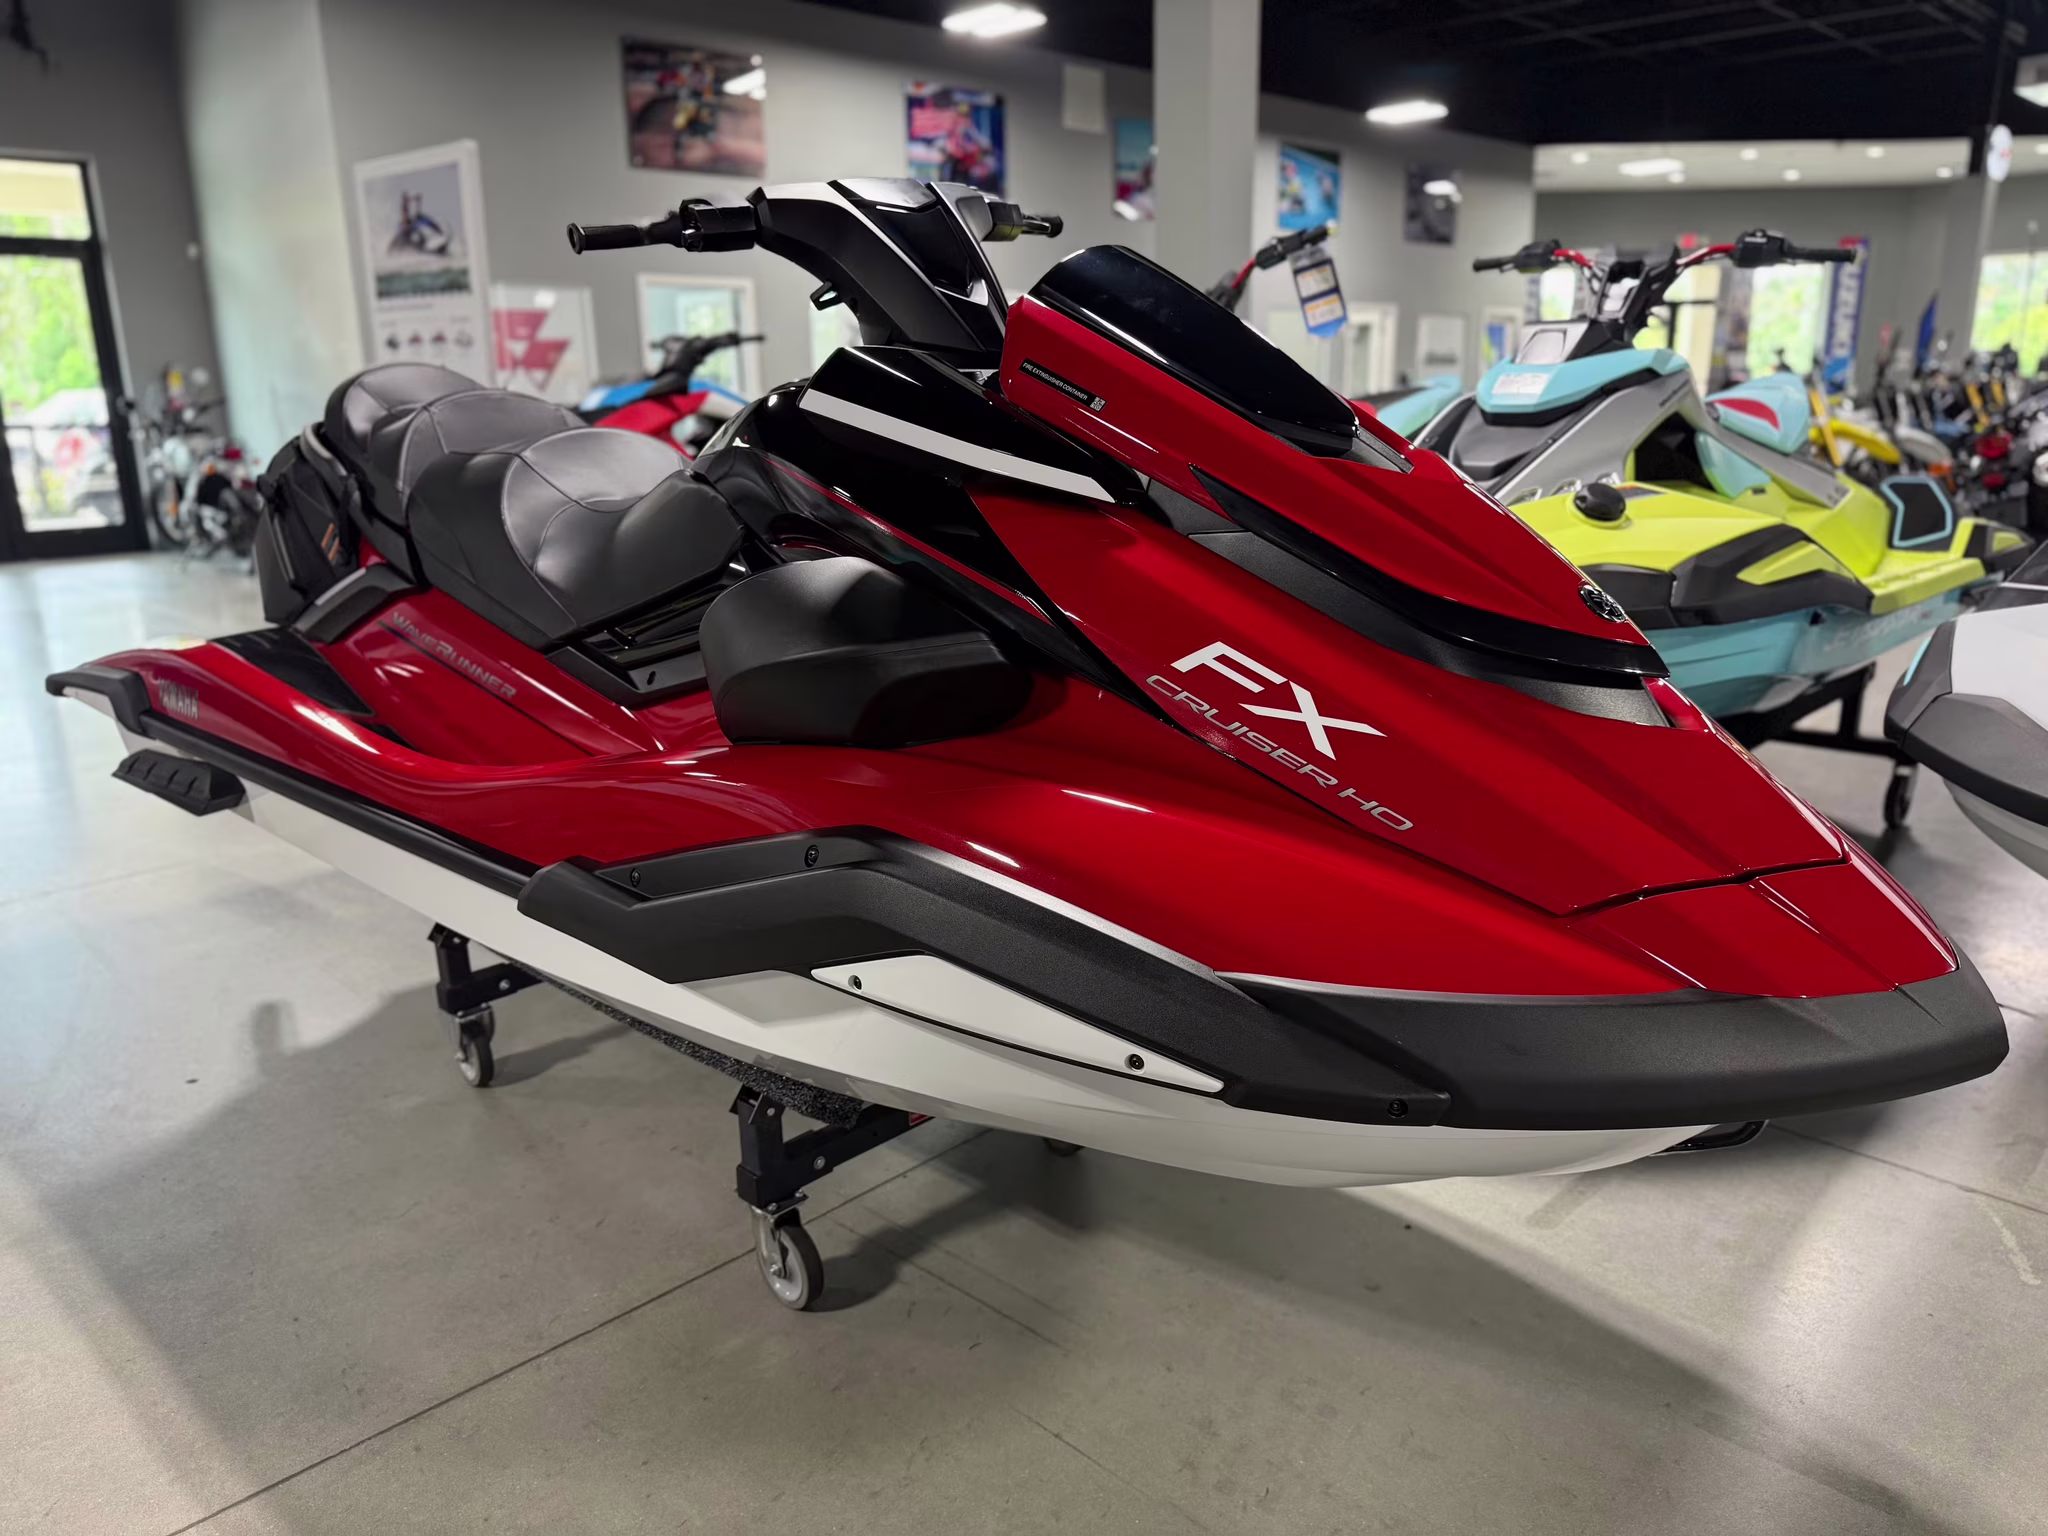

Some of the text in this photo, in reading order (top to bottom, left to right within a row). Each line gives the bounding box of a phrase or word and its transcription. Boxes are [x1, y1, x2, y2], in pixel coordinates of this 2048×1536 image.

[1022, 362, 1088, 401] FIRE EXTINGUISHER CONTAINER
[1145, 674, 1414, 831] CRUISER HO
[1169, 640, 1388, 761] FX
